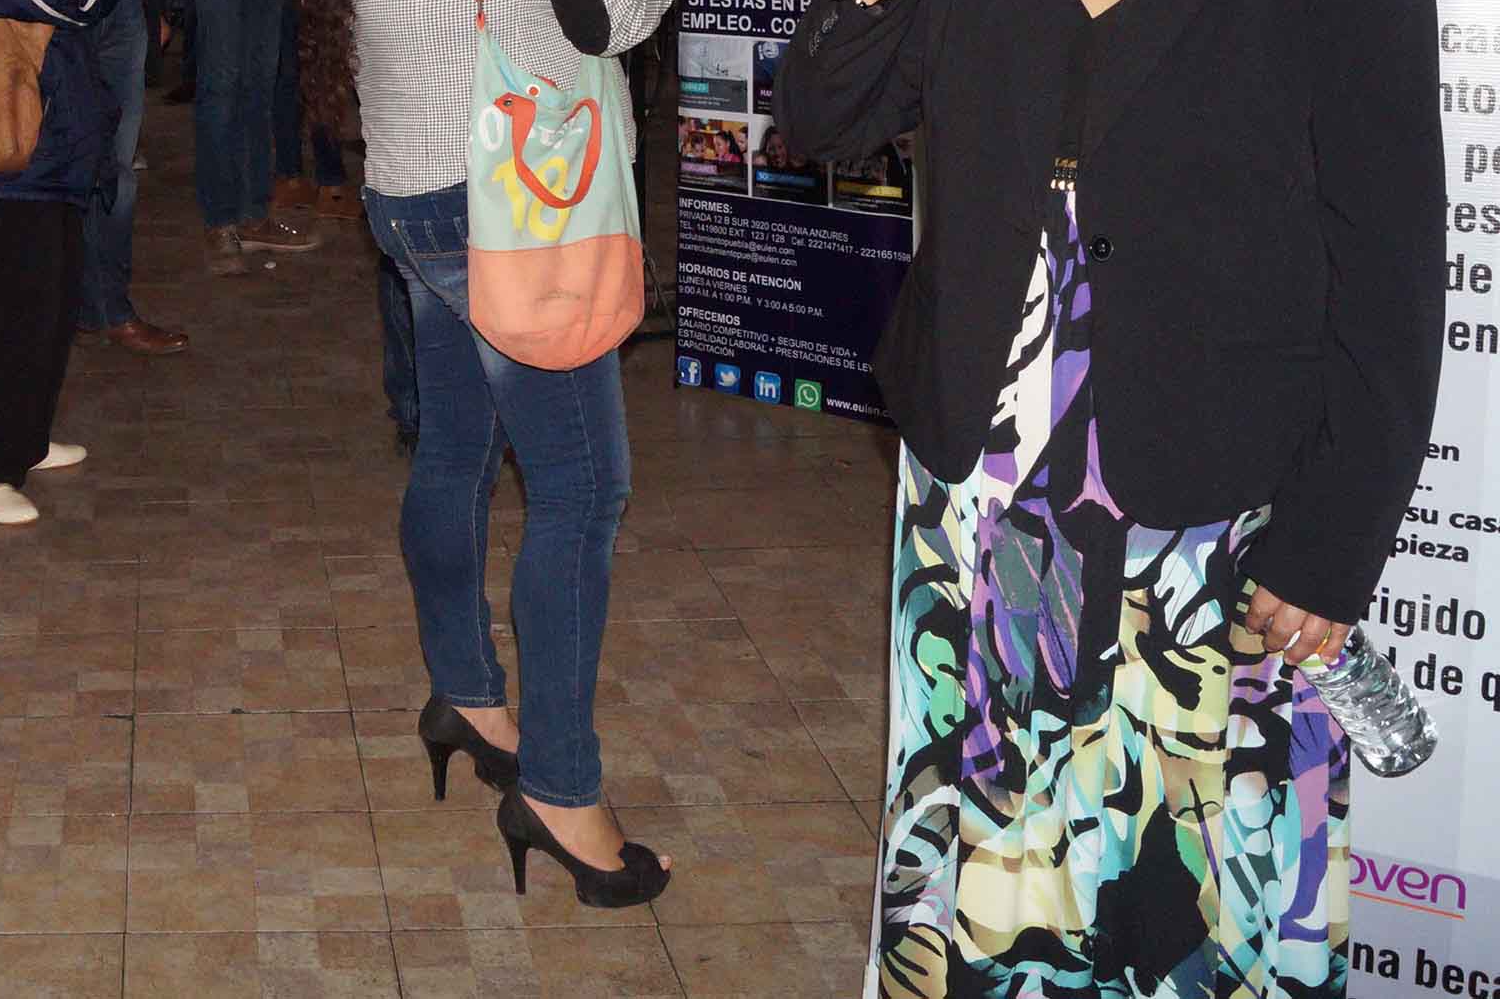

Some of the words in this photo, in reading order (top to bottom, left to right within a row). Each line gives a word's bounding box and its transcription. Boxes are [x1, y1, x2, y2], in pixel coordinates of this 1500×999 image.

[682, 11, 766, 33] EMPLEO...
[770, 17, 800, 35] CO
[678, 197, 733, 214] INFORMES:
[731, 217, 749, 227] SUR
[771, 223, 808, 236] COLONIA
[808, 227, 849, 242] ANZURES
[678, 262, 730, 280] HORARIOS
[732, 271, 747, 282] DE
[749, 273, 802, 291] ATENCIÓN
[678, 306, 741, 326] OFRECEMOS
[757, 297, 763, 307] Y
[678, 318, 712, 332] SALARIO
[712, 324, 769, 342] COMPETITIVO
[777, 336, 814, 351] SEGURO
[815, 342, 828, 353] DE
[830, 345, 851, 357] VIDA
[1448, 320, 1499, 354] en
[728, 337, 768, 353] LABORAL
[775, 346, 841, 367] PRESTACIONES
[842, 358, 855, 370] DE
[1405, 505, 1438, 525] su
[1449, 511, 1500, 534] cas
[1413, 653, 1463, 696] de
